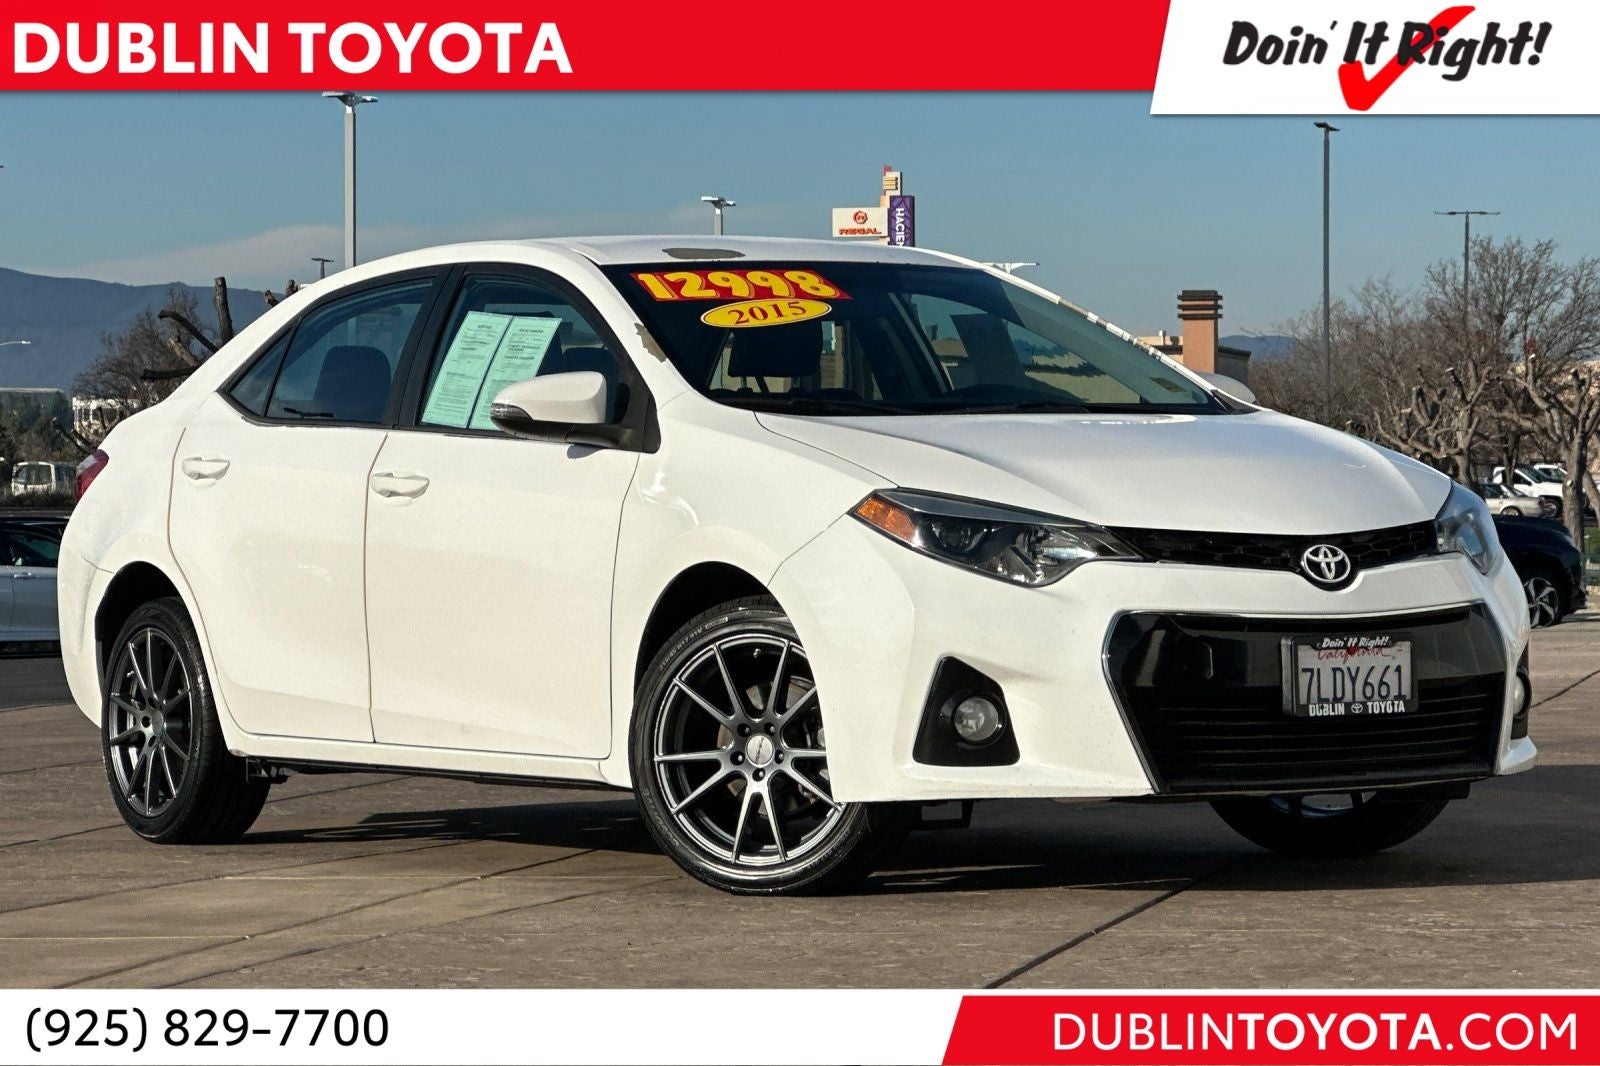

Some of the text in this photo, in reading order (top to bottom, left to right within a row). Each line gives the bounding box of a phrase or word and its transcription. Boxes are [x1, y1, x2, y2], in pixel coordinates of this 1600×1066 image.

[839, 227, 882, 236] REGAL
[637, 270, 841, 299] 12998
[727, 301, 807, 326] 2015
[1321, 635, 1390, 650] Doin' It Right!
[1317, 646, 1391, 664] Califrnia
[1301, 664, 1407, 703] 7LDY661
[1308, 700, 1406, 717] DUBLIN TOYOTA
